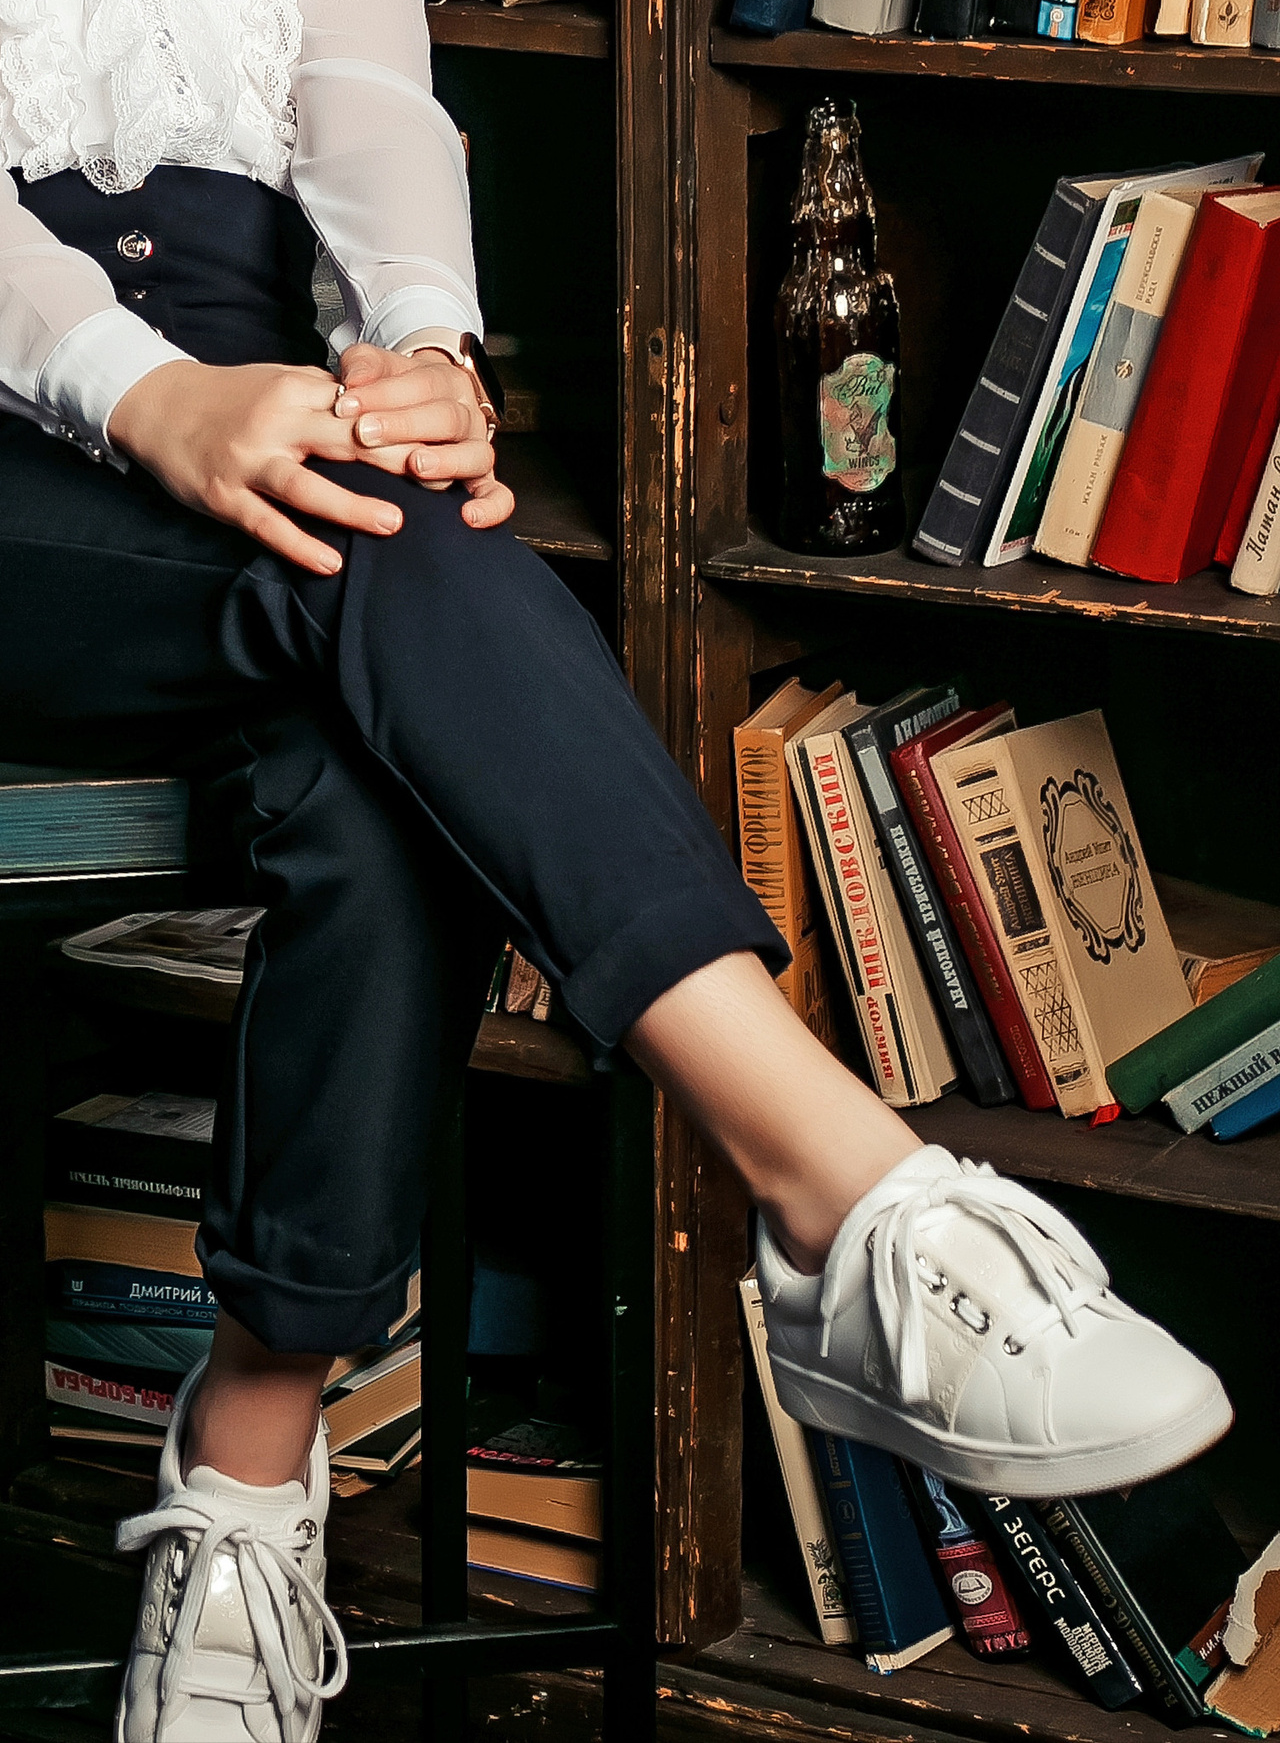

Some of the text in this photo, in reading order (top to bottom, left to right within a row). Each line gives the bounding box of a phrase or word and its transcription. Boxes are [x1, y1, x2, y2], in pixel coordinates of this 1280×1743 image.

[1245, 486, 1280, 562] Натан
[731, 746, 781, 854] ФРЕГАТОВ
[814, 752, 894, 1079] ВИКТОР ШКЛОВСКИЙ
[890, 825, 968, 1009] АНАТОЛИЙ ПРИСТАВКИН
[1192, 1053, 1271, 1114] НЕЖНЫЙ
[69, 1171, 201, 1200] НЕФРИТОВЫЕ ЧЕТКИ
[129, 1282, 202, 1303] ДМИТРИЙ
[47, 1364, 138, 1411] БОРЬБА
[1003, 1517, 1065, 1604] ЗЕГЕРС
